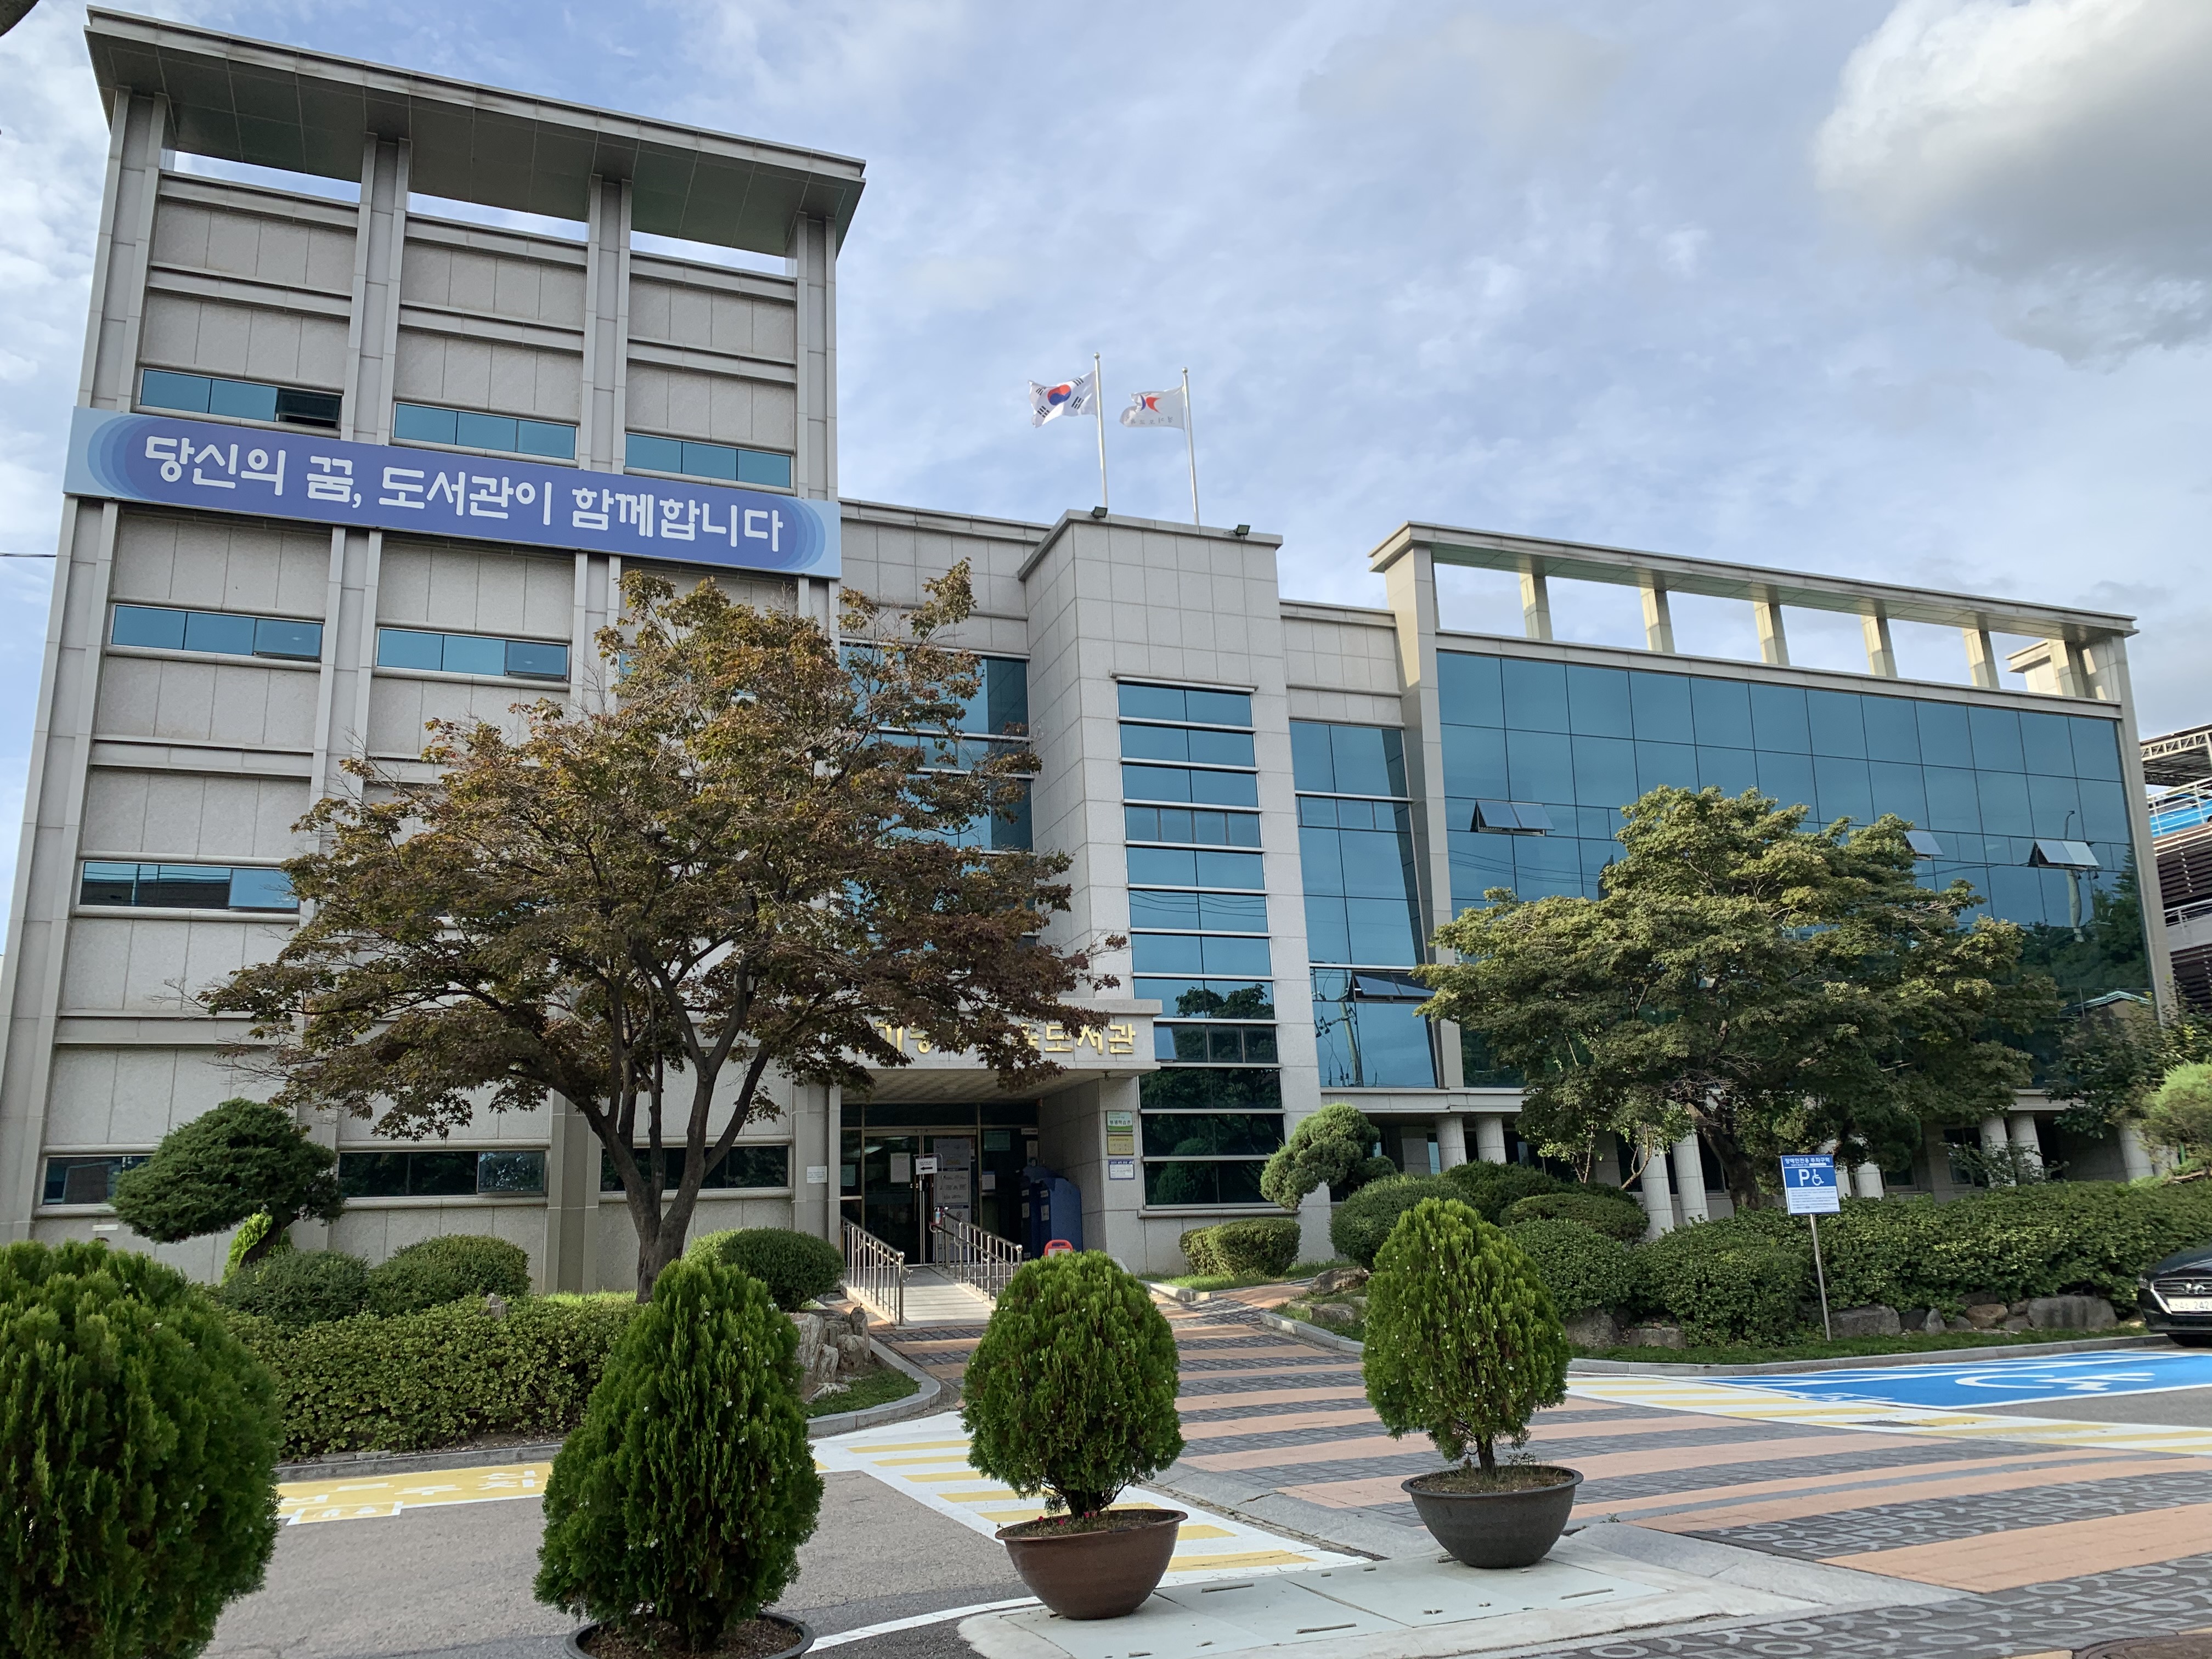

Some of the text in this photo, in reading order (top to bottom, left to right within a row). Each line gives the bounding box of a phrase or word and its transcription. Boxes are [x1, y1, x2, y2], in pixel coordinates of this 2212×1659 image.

[145, 436, 785, 552] 당신의 꿈, 도서관이 함께합니다
[1798, 1169, 1810, 1186] P
